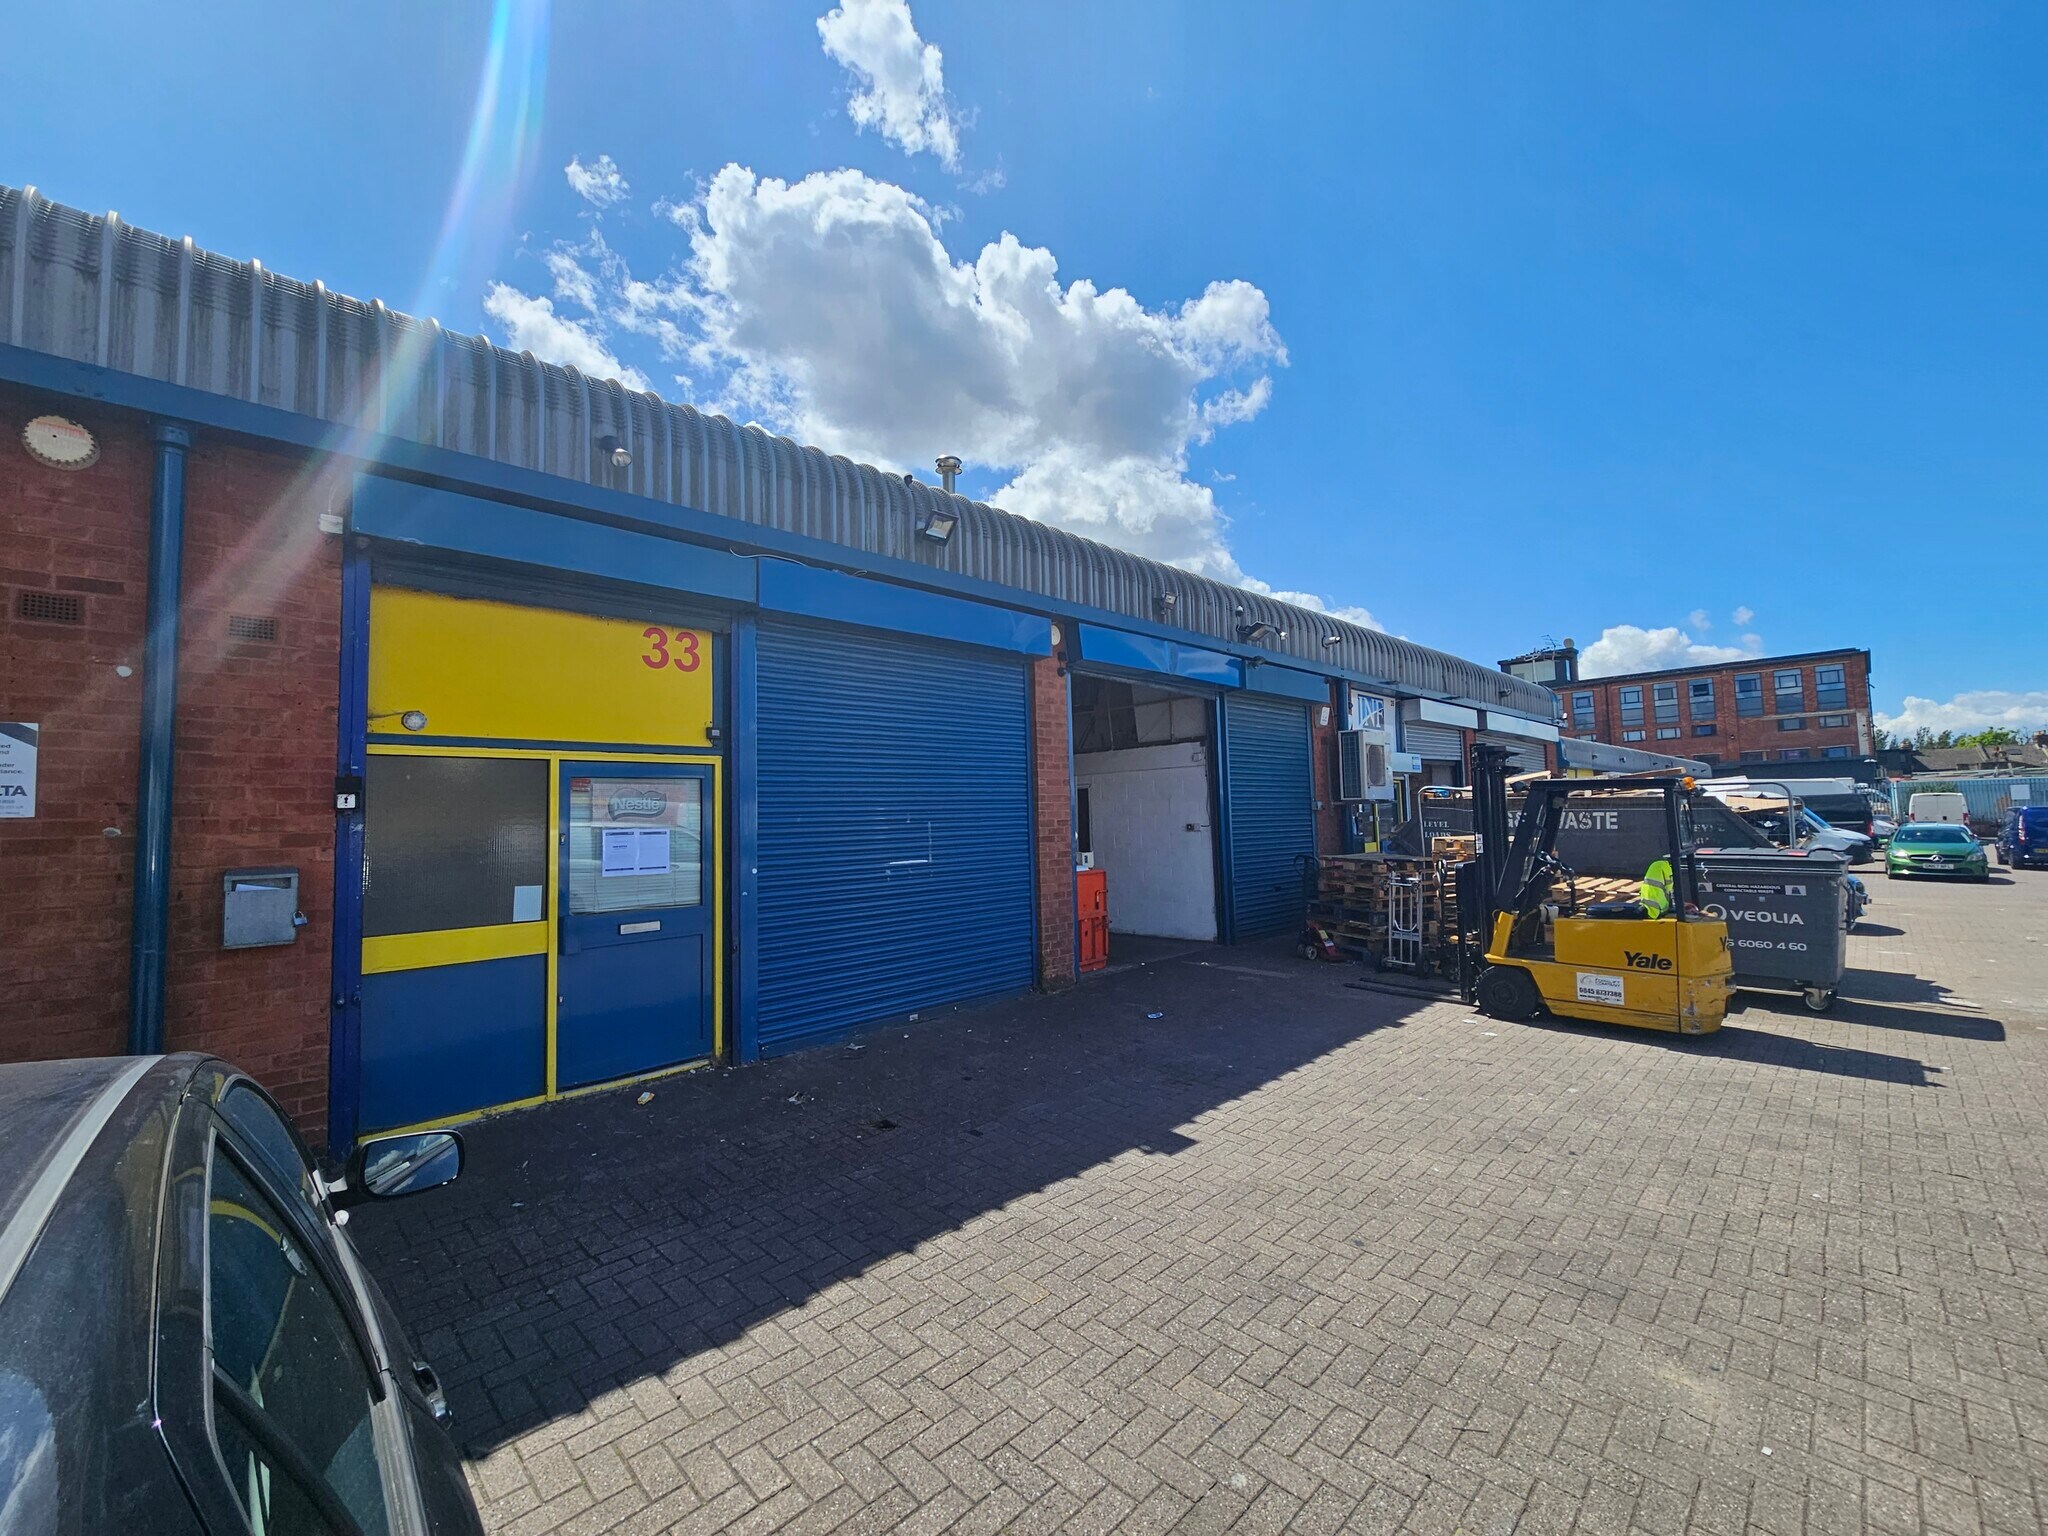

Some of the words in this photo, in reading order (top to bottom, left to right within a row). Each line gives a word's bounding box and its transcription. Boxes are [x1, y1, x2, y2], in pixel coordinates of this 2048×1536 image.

[642, 627, 700, 672] 33
[1423, 820, 1450, 828] LEVEL
[1730, 910, 1804, 925] VEOLIA
[1738, 939, 1773, 949] 6060
[1624, 951, 1673, 971] Yale
[1579, 987, 1595, 995] 0845
